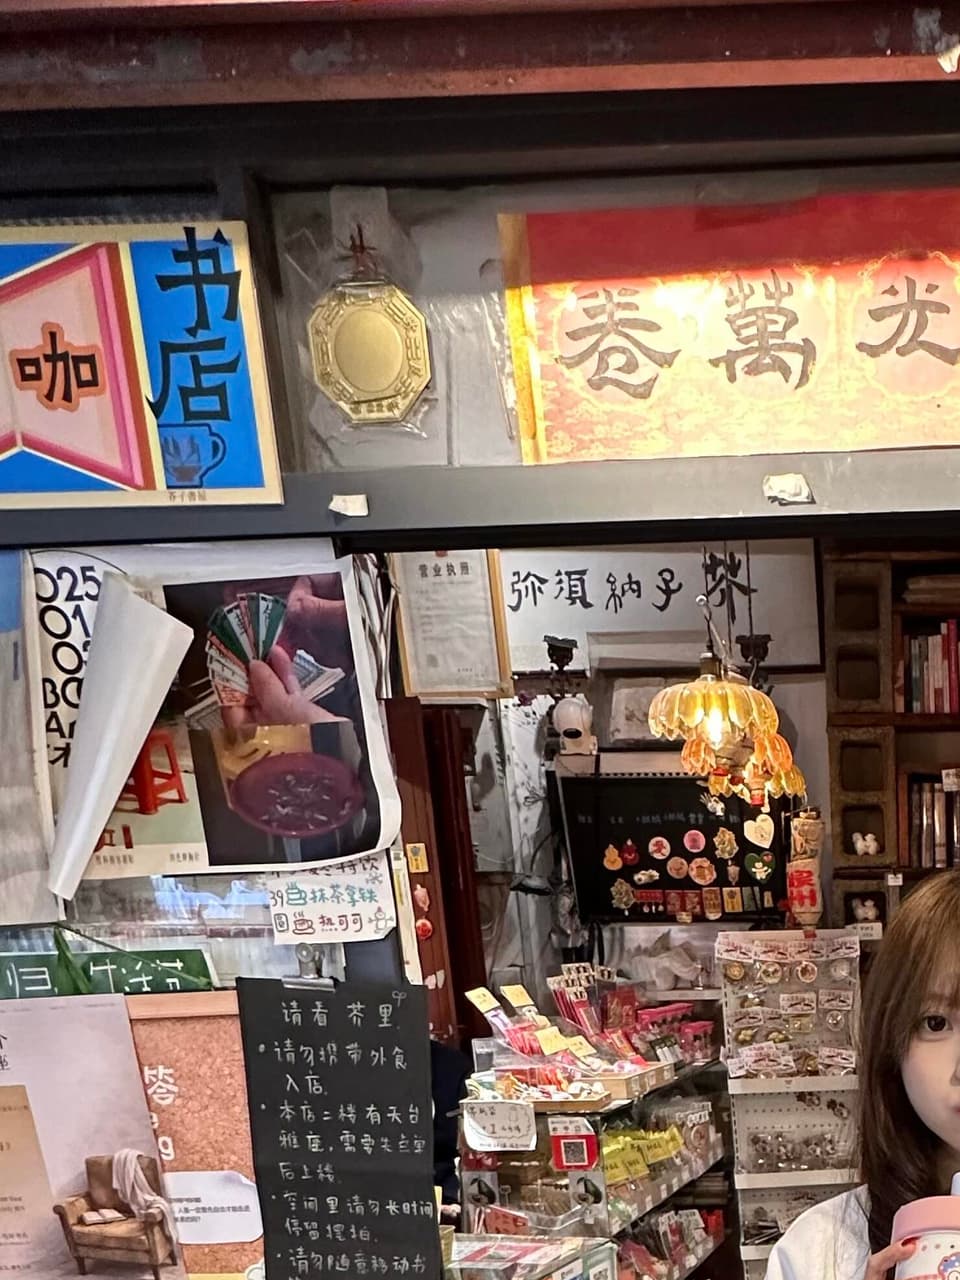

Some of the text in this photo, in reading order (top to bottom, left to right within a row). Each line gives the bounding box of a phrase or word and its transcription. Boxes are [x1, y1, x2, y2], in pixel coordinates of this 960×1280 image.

[145, 227, 242, 422] 书店
[18, 331, 99, 403] 咖
[310, 883, 379, 908] 抹茶拿铁
[318, 912, 363, 933] 热可可
